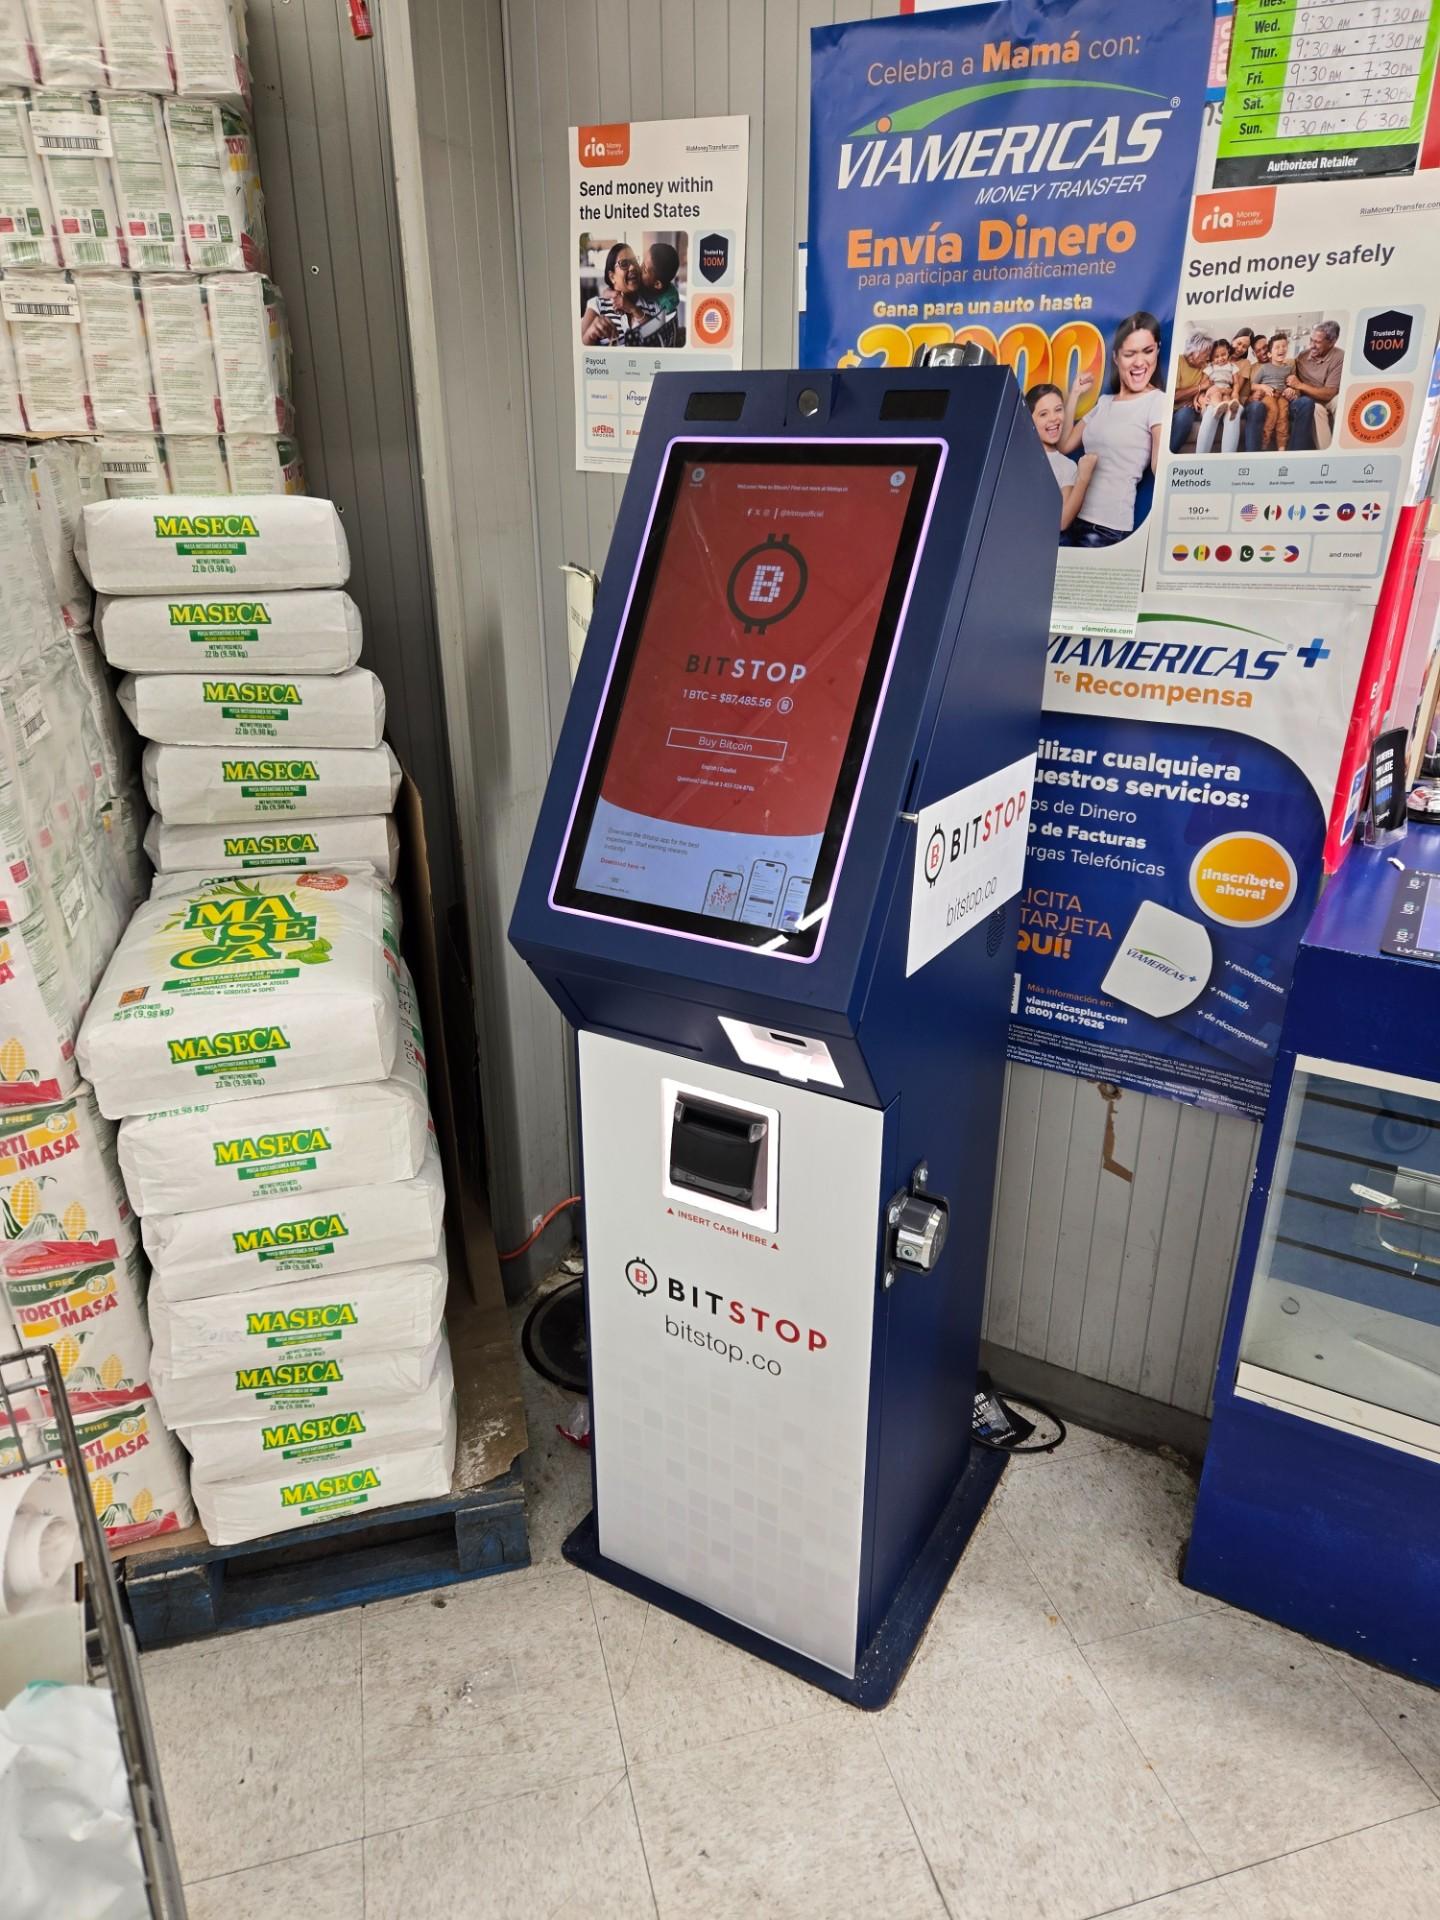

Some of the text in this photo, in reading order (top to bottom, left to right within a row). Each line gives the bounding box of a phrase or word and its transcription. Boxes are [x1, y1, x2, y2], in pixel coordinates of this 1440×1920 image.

[1255, 19, 1280, 34] Wed.
[867, 31, 1142, 87] Celebra a Mamá con:
[1251, 46, 1277, 59] Thur.
[1246, 71, 1264, 85] Fri.
[1243, 97, 1264, 110] Sat.
[1239, 122, 1262, 136] Sun.
[584, 137, 605, 158] ria
[837, 110, 1173, 190] VIAMERICAS
[1267, 156, 1358, 172] Authorized Retailer
[579, 176, 713, 197] Send money within
[974, 174, 1147, 206] MONEY TRANSFER
[580, 202, 700, 220] the United States
[1201, 206, 1233, 231] ria
[1236, 210, 1260, 219] Money
[1236, 218, 1264, 227] Transfer
[847, 214, 1137, 269] Envía Dinero
[703, 257, 725, 267] 100M
[1188, 244, 1395, 278] Send money safely
[858, 260, 1117, 291] para participar automáticamente
[1186, 281, 1295, 306] worldwide
[873, 293, 1093, 321] Gana para un auto hasta
[1370, 338, 1404, 351] 100M
[1373, 329, 1405, 338] Trusted by
[585, 357, 606, 367] Payout
[585, 367, 609, 376] Options
[1171, 477, 1211, 488] Methods
[1172, 467, 1204, 478] Payout
[1188, 506, 1210, 515] 190+
[154, 515, 260, 538] MASECA
[1329, 550, 1362, 559] and more!
[192, 564, 199, 573] 22
[168, 602, 272, 626] MASECA
[1081, 624, 1133, 635] viamericas.com
[685, 654, 807, 684] BITSTOP
[203, 682, 302, 705] MASECA
[689, 690, 709, 701] BTC
[1054, 671, 1253, 708] Te Recompensa
[698, 737, 753, 752] Buy Bitcoin
[222, 760, 320, 782] MASECA
[1102, 750, 1241, 782] cualquiera
[1125, 779, 1250, 809] servicios:
[1053, 799, 1074, 815] de
[1080, 803, 1137, 824] Dinero
[950, 790, 1027, 862] BITSTOP
[1041, 822, 1063, 837] de
[1067, 825, 1146, 849] Facturas
[224, 834, 320, 857] MASECA
[1071, 849, 1165, 877] Telefónicas
[946, 876, 998, 927] bitstop.co
[1022, 887, 1082, 912] ICITA
[1215, 884, 1266, 901] ahora!
[1232, 960, 1285, 995] recompensas
[1027, 983, 1045, 994] Más
[1047, 988, 1098, 1006] información
[1217, 988, 1250, 1011] rewards
[1025, 1005, 1105, 1030] (800) 401-7626
[1026, 996, 1128, 1025] viamericasplus.com
[1204, 1012, 1215, 1022] de
[167, 1026, 291, 1064] MASECA
[17, 1132, 80, 1170] MASA
[213, 1128, 332, 1166] MASECA
[233, 1213, 349, 1254] MASECA
[678, 1210, 767, 1247] INSERT CASH HERE
[48, 1278, 76, 1290] FREE
[16, 1296, 71, 1325] TORTI
[59, 1293, 119, 1329] MASA
[247, 1303, 358, 1335] MASECA
[668, 1277, 828, 1352] BITSTOP
[665, 1315, 782, 1376] bitstop.co
[236, 1360, 343, 1391] MASECA
[262, 1411, 367, 1451] MASECA
[94, 1434, 150, 1471] MASA
[280, 1467, 381, 1507] MASECA
